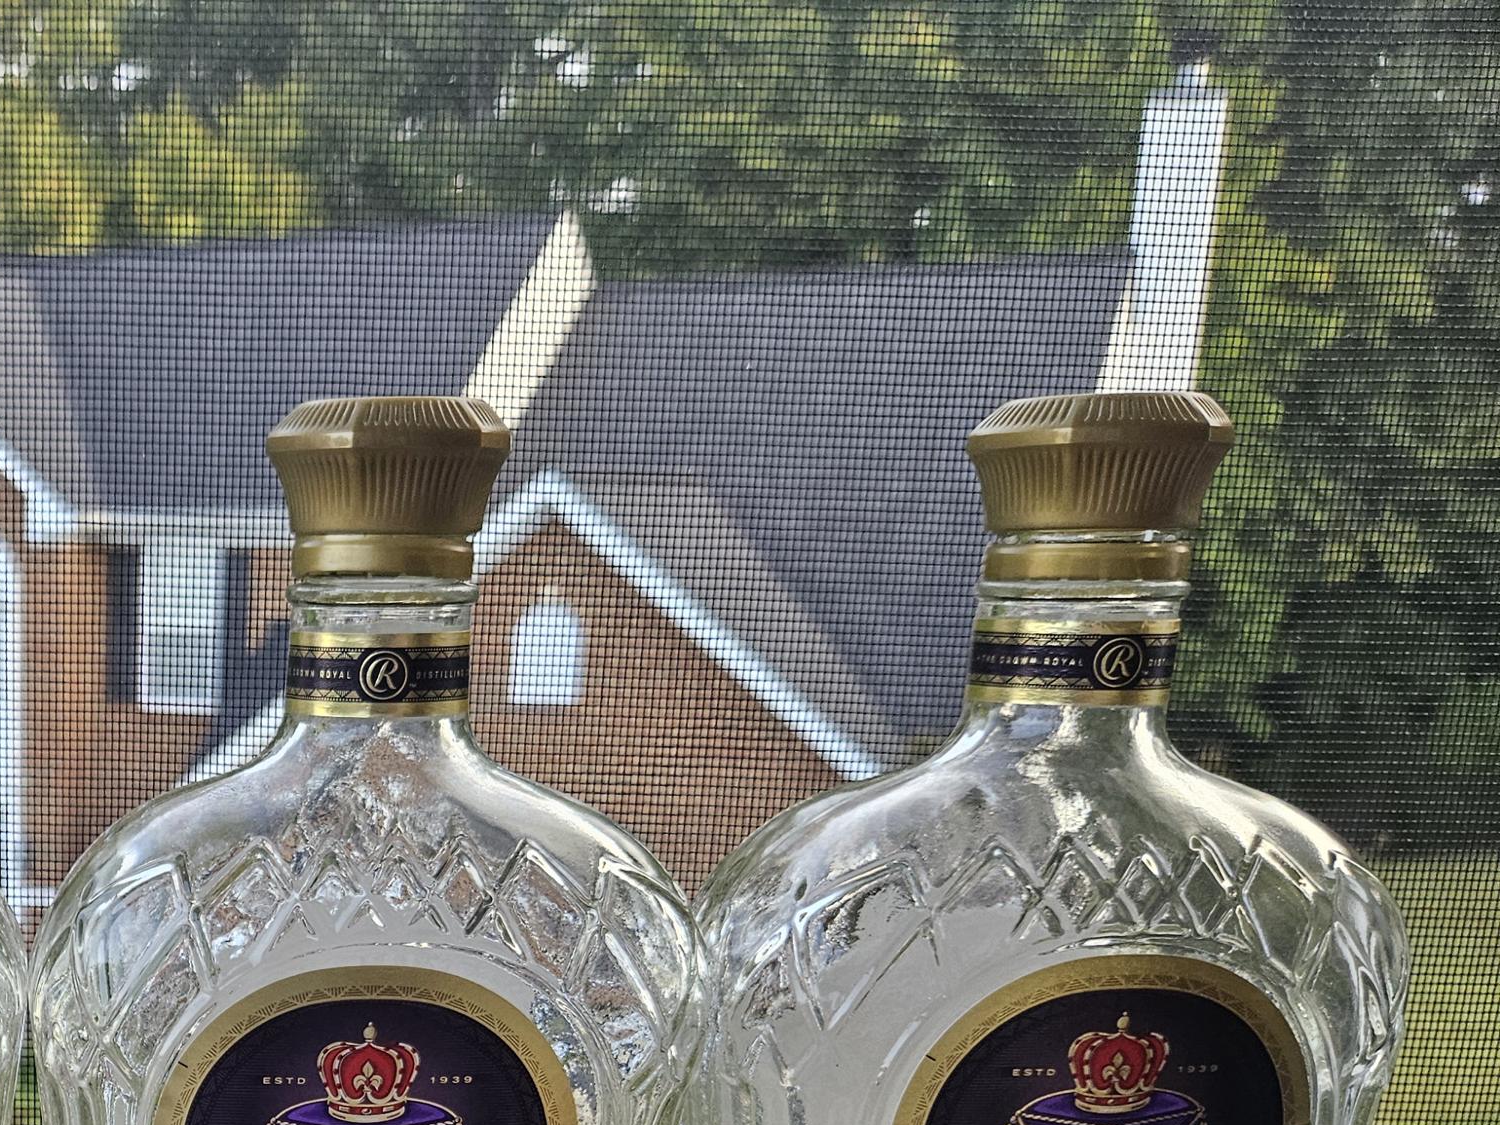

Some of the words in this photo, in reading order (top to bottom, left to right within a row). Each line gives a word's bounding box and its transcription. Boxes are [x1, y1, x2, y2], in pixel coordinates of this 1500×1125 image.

[1000, 655, 1037, 666] CROWN
[1044, 657, 1083, 667] ROYAL
[319, 670, 351, 680] ROYAL
[1012, 1067, 1056, 1077] ESTD
[1177, 1064, 1219, 1073] 1939
[262, 1075, 306, 1085] ESTD
[430, 1074, 473, 1084] 1939
